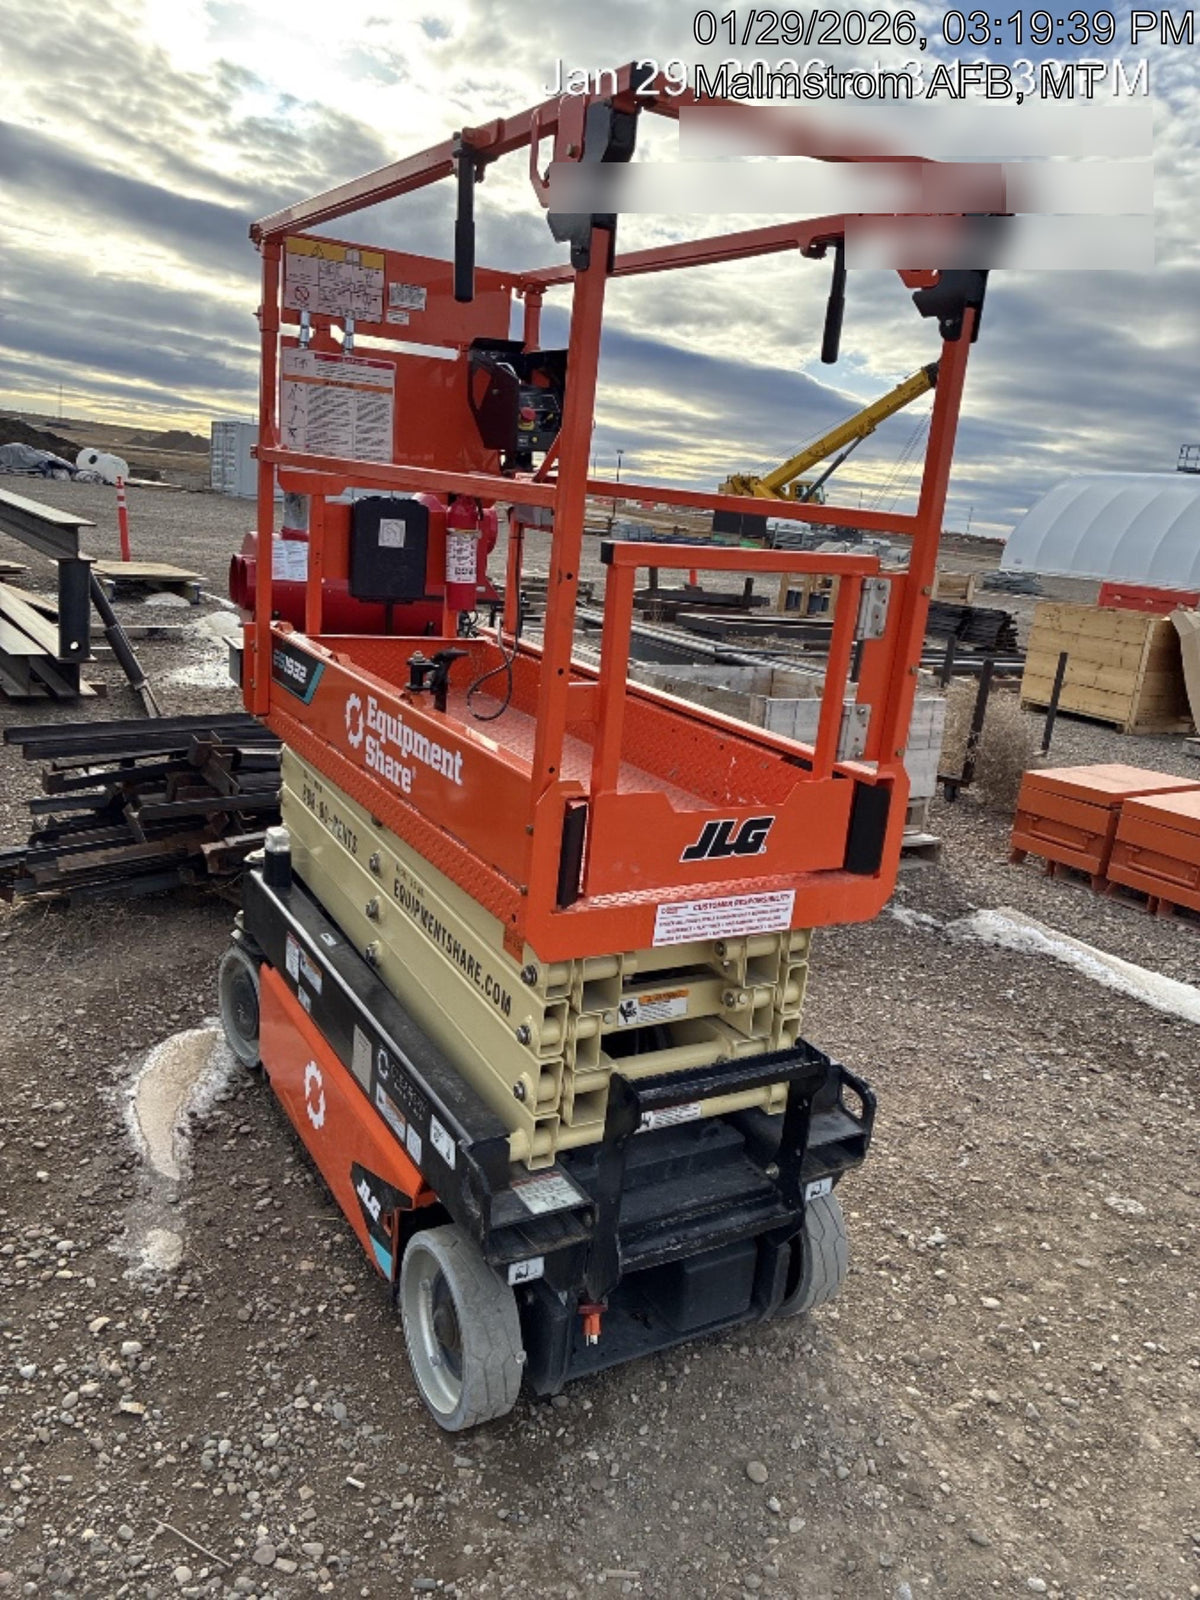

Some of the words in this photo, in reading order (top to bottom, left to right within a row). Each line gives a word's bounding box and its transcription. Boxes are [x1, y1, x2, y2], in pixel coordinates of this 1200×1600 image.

[365, 733, 412, 794] Share
[366, 694, 464, 787] Equipment
[679, 815, 776, 863] JLG
[394, 878, 513, 1017] EQUIPMENTSHARE.COM
